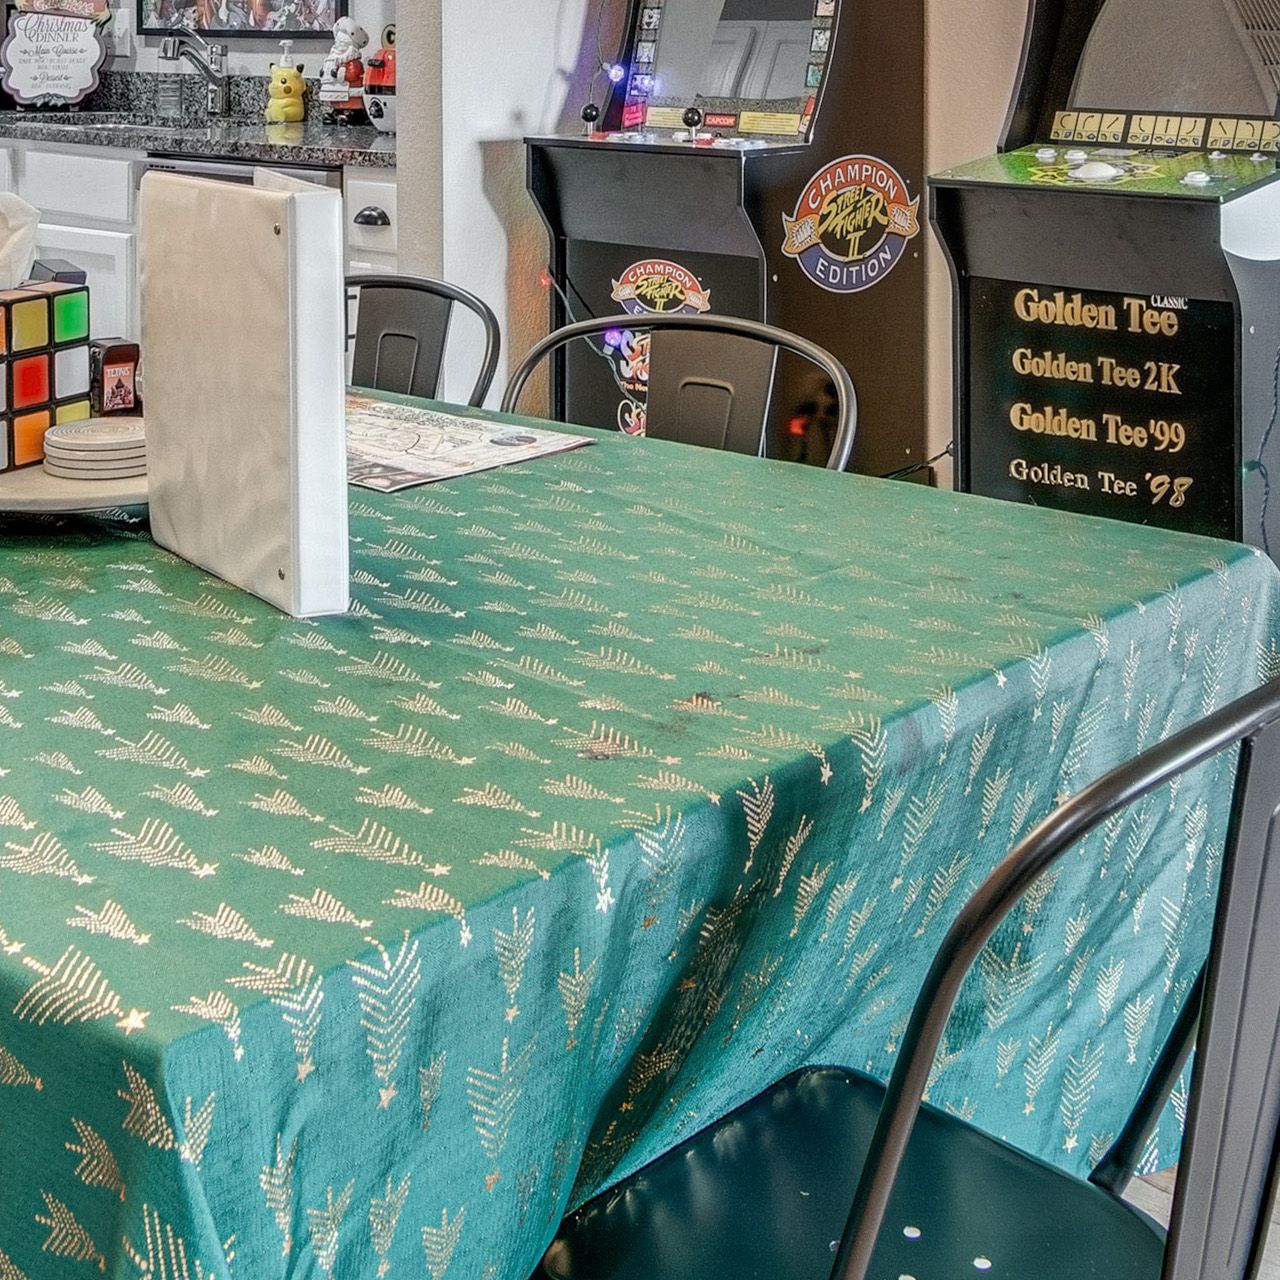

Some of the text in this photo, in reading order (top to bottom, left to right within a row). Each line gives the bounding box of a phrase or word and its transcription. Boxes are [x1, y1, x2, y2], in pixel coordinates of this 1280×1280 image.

[16, 13, 88, 42] Christmas
[36, 32, 79, 42] DINNER
[706, 115, 737, 126] CAPCOM
[808, 163, 898, 209] CHAMPION
[818, 183, 867, 236] STREET
[816, 245, 892, 285] EDITION
[845, 230, 867, 262] II
[628, 265, 693, 288] CHAMPION
[1014, 288, 1178, 336] Golden Tee
[1150, 294, 1188, 310] CLASSIC
[1012, 348, 1182, 395] Golden Tee 2K
[1010, 403, 1186, 453] Golden Tee '99
[1009, 459, 1193, 508] Golden Tee '98
